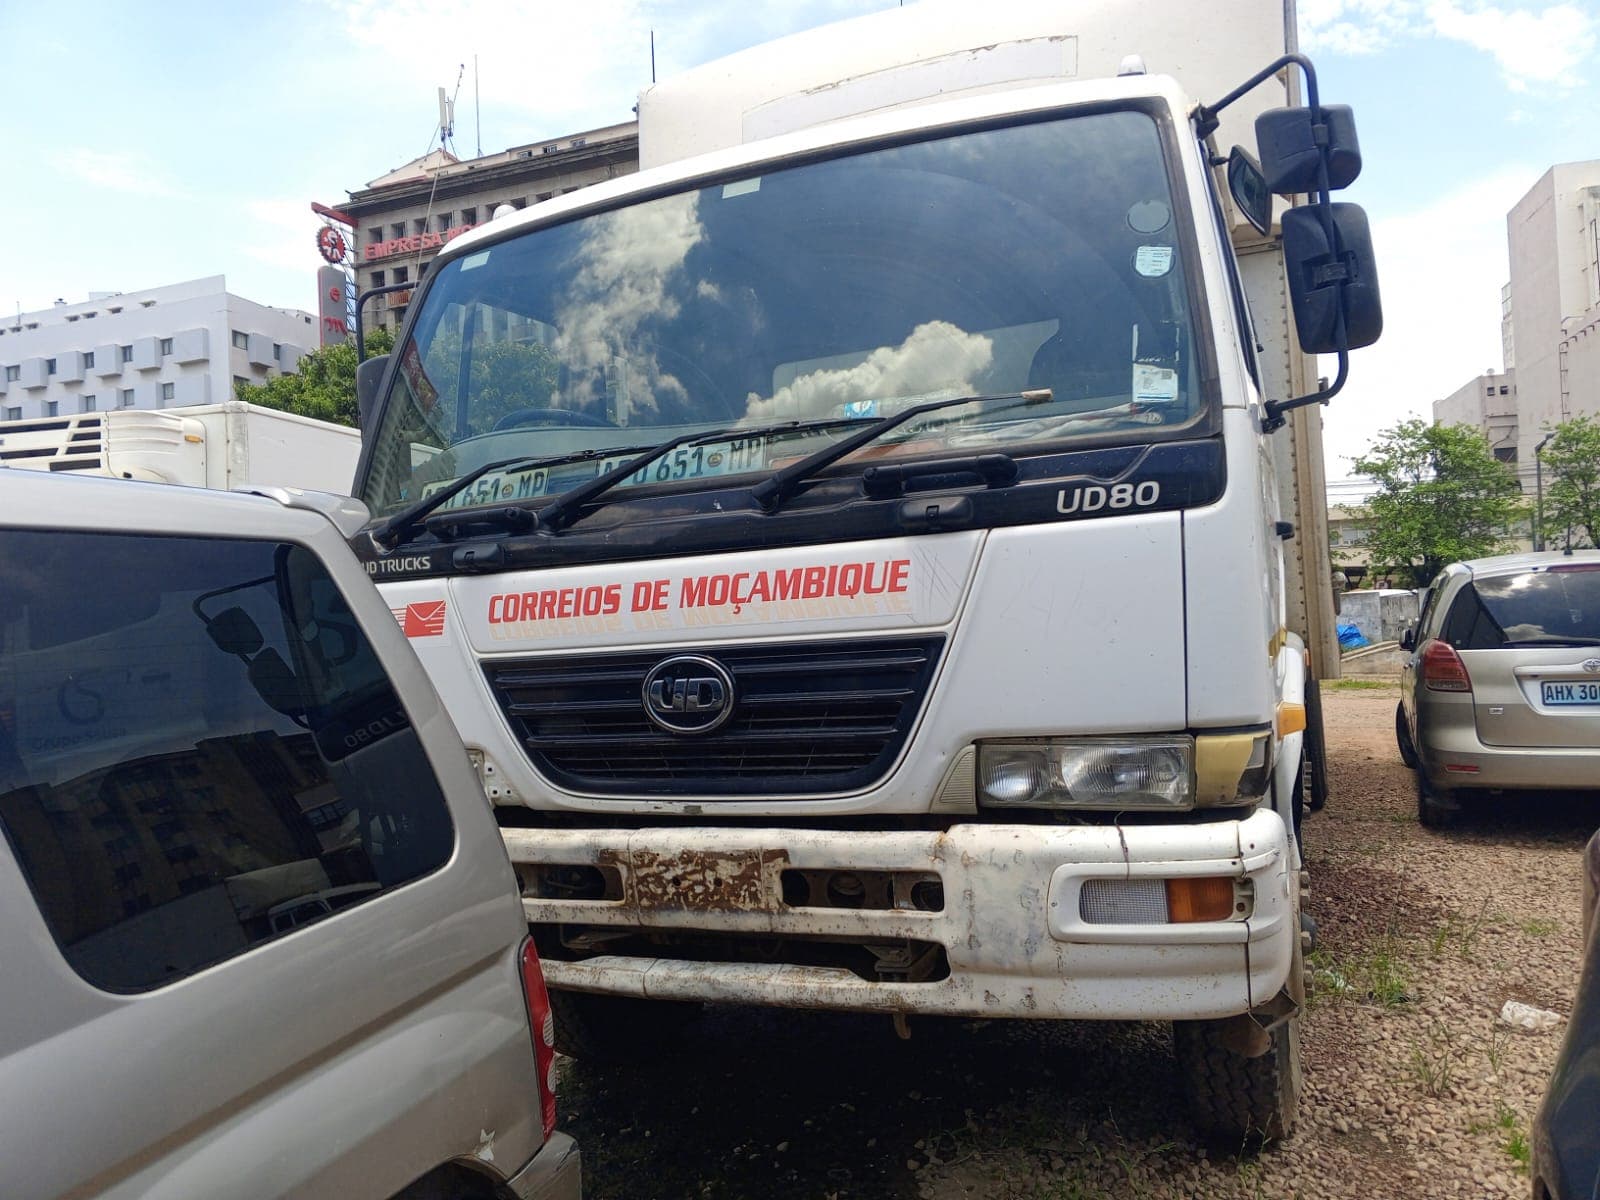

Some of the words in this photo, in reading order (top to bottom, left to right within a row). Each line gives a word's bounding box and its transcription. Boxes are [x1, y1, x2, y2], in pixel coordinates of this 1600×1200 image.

[364, 232, 444, 260] EMPRESA
[656, 446, 704, 481] 651
[729, 438, 761, 471] MP
[519, 471, 545, 497] MP
[1056, 480, 1160, 514] UD80
[379, 556, 432, 573] TRUCKS
[488, 584, 623, 624] CORREIOS
[630, 579, 670, 613] DE
[679, 559, 911, 615] MOÇAMBIQUE
[1545, 684, 1574, 701] AHX
[1578, 684, 1600, 700] 30
